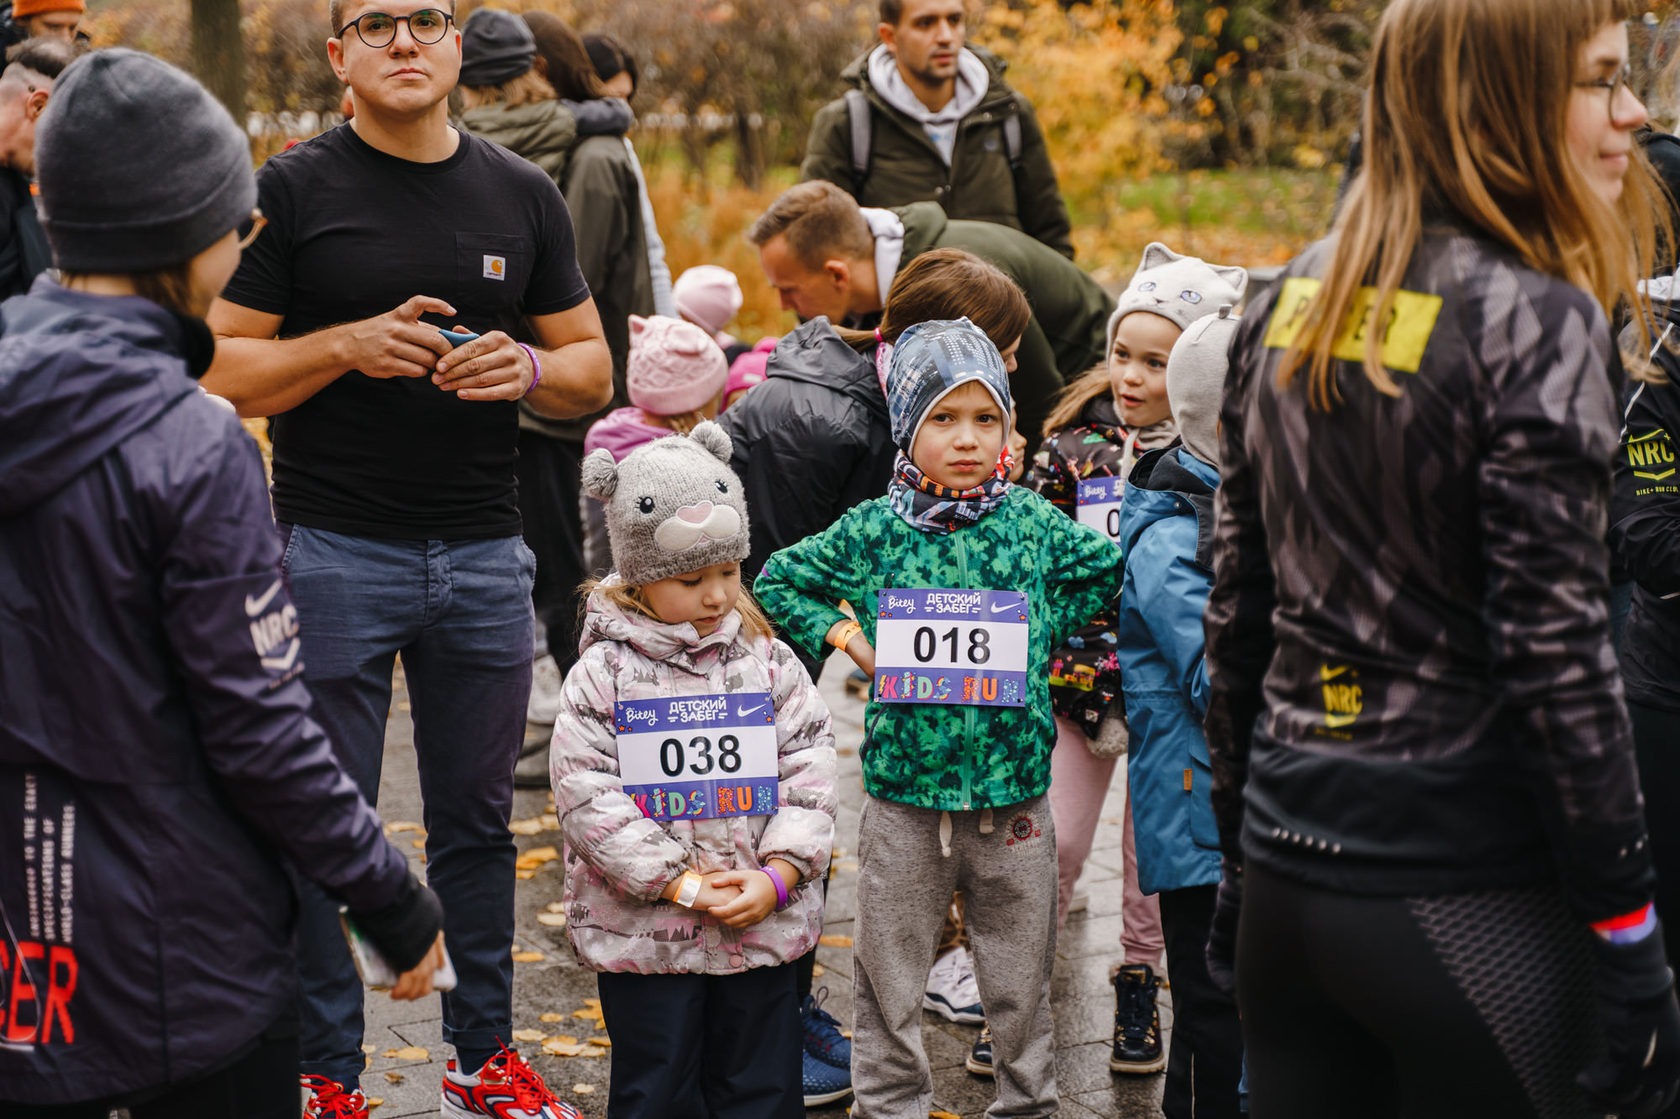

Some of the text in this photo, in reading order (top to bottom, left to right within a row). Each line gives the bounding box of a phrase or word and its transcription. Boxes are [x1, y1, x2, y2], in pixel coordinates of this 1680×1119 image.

[1627, 441, 1675, 466] NRC
[888, 596, 916, 614] Bitey
[926, 592, 982, 606] ДЕТСКИЙ
[935, 603, 973, 614] ЗАБЕГ
[249, 603, 298, 657] NRC
[913, 626, 991, 665] 018
[961, 676, 1018, 703] RUN
[1322, 685, 1363, 715] NRC
[626, 708, 659, 726] Bitey
[669, 696, 727, 714] ДЕТСКИЙ
[680, 709, 719, 723] ЗАБЕГ
[660, 735, 742, 777] 038
[717, 786, 772, 814] RUN
[24, 817, 36, 839] THE
[42, 819, 56, 940] SPECIFICATIONS OF
[60, 863, 73, 942] WORLD-CLASS
